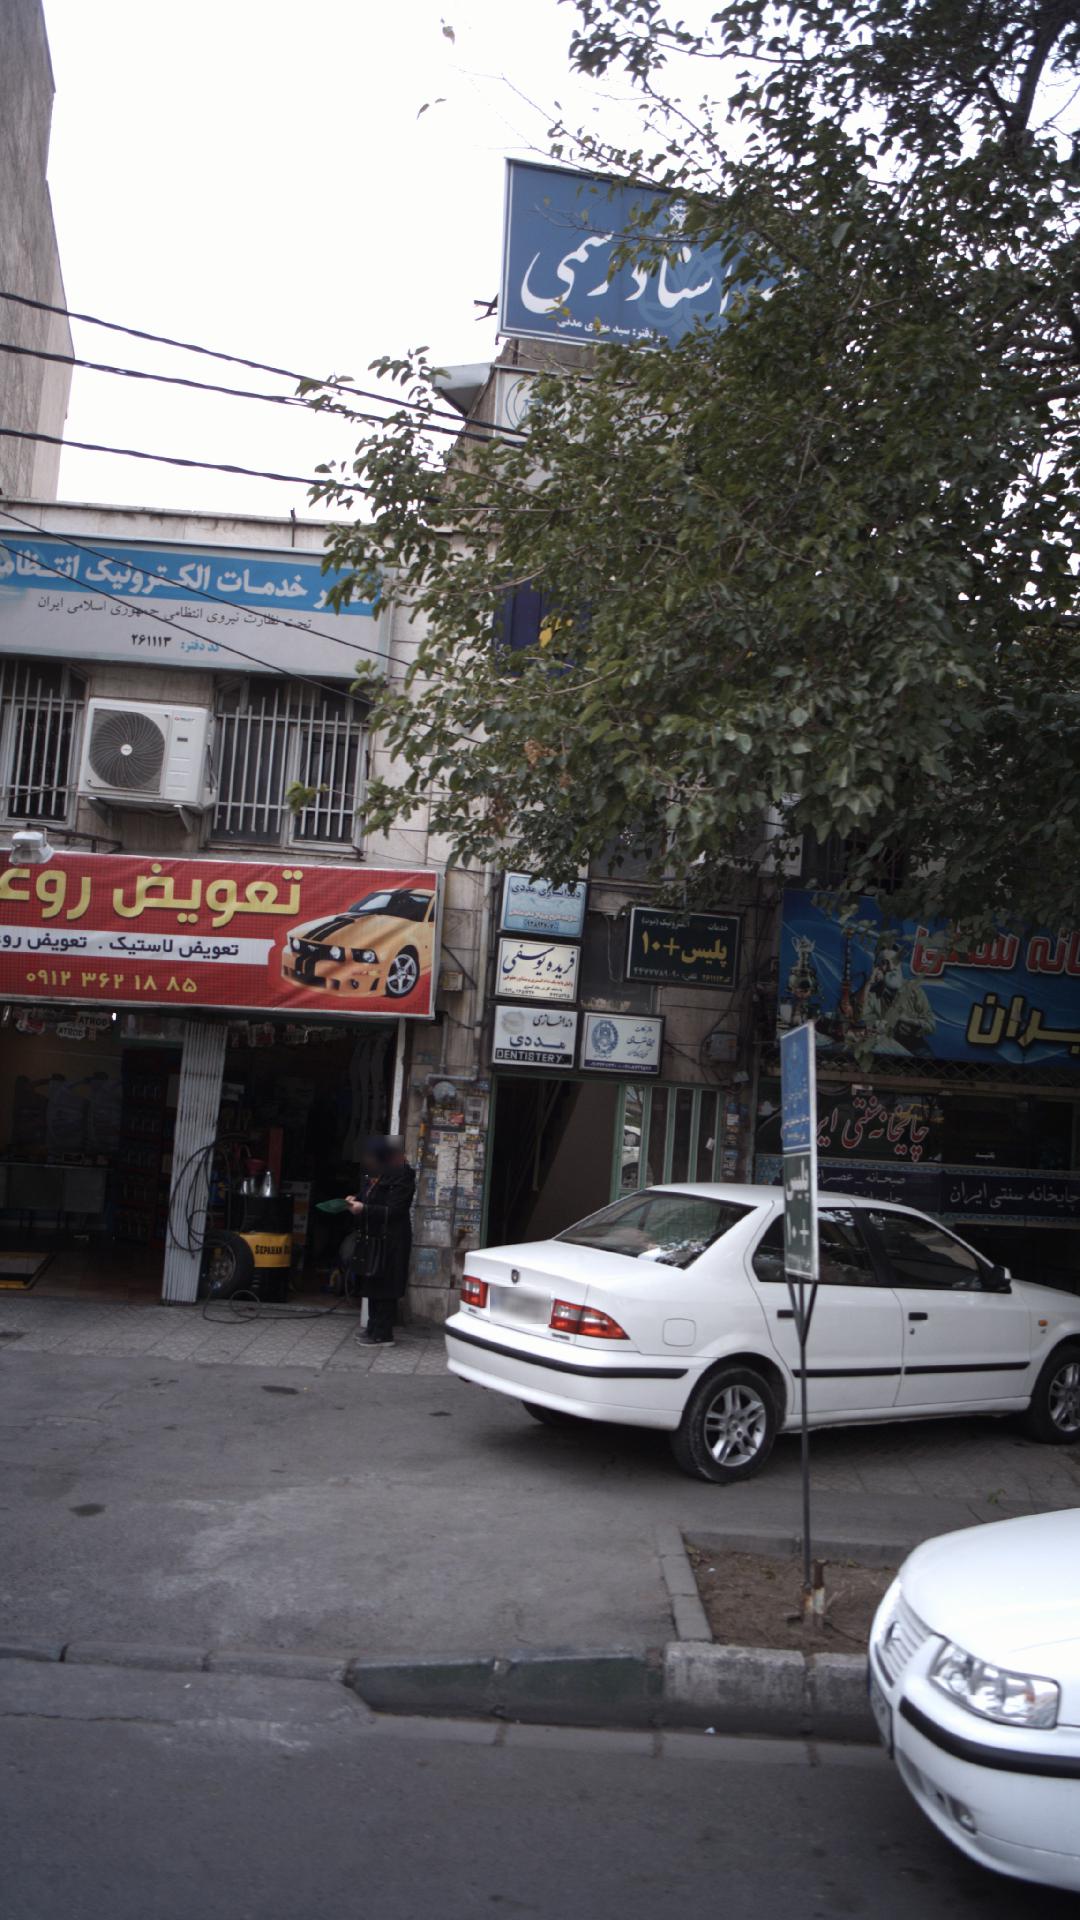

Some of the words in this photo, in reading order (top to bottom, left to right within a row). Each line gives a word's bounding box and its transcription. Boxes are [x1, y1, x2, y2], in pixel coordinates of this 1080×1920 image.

[613, 324, 631, 337] سید
[0, 548, 81, 581] انتظام
[86, 556, 211, 595] الکترونیک
[217, 568, 308, 598] خدمات
[38, 596, 64, 611] ایران
[67, 599, 107, 614] اسلامی
[110, 603, 159, 619] جمهوری
[163, 607, 203, 622] انتظامی
[207, 614, 239, 627] نیروی
[244, 612, 280, 628] نظارت
[131, 633, 172, 646] ۲۶۱۱۱۳
[113, 864, 304, 929] تعویض
[27, 932, 88, 952] تعویض
[108, 936, 174, 957] لاستیک
[179, 941, 240, 961] تعویض
[1026, 927, 1080, 977] انه
[681, 938, 728, 968] پلیس
[26, 969, 72, 987] ۰۹۱۲
[82, 971, 125, 990] ۳۶۲
[134, 975, 158, 991] ۱۸
[166, 976, 198, 993] ۸۵
[532, 1013, 573, 1028] دندانسازی
[510, 1035, 566, 1049] عددی
[496, 1049, 562, 1064] DENTISTERY
[949, 1180, 988, 1205] ایران
[989, 1185, 1025, 1209] سنتی
